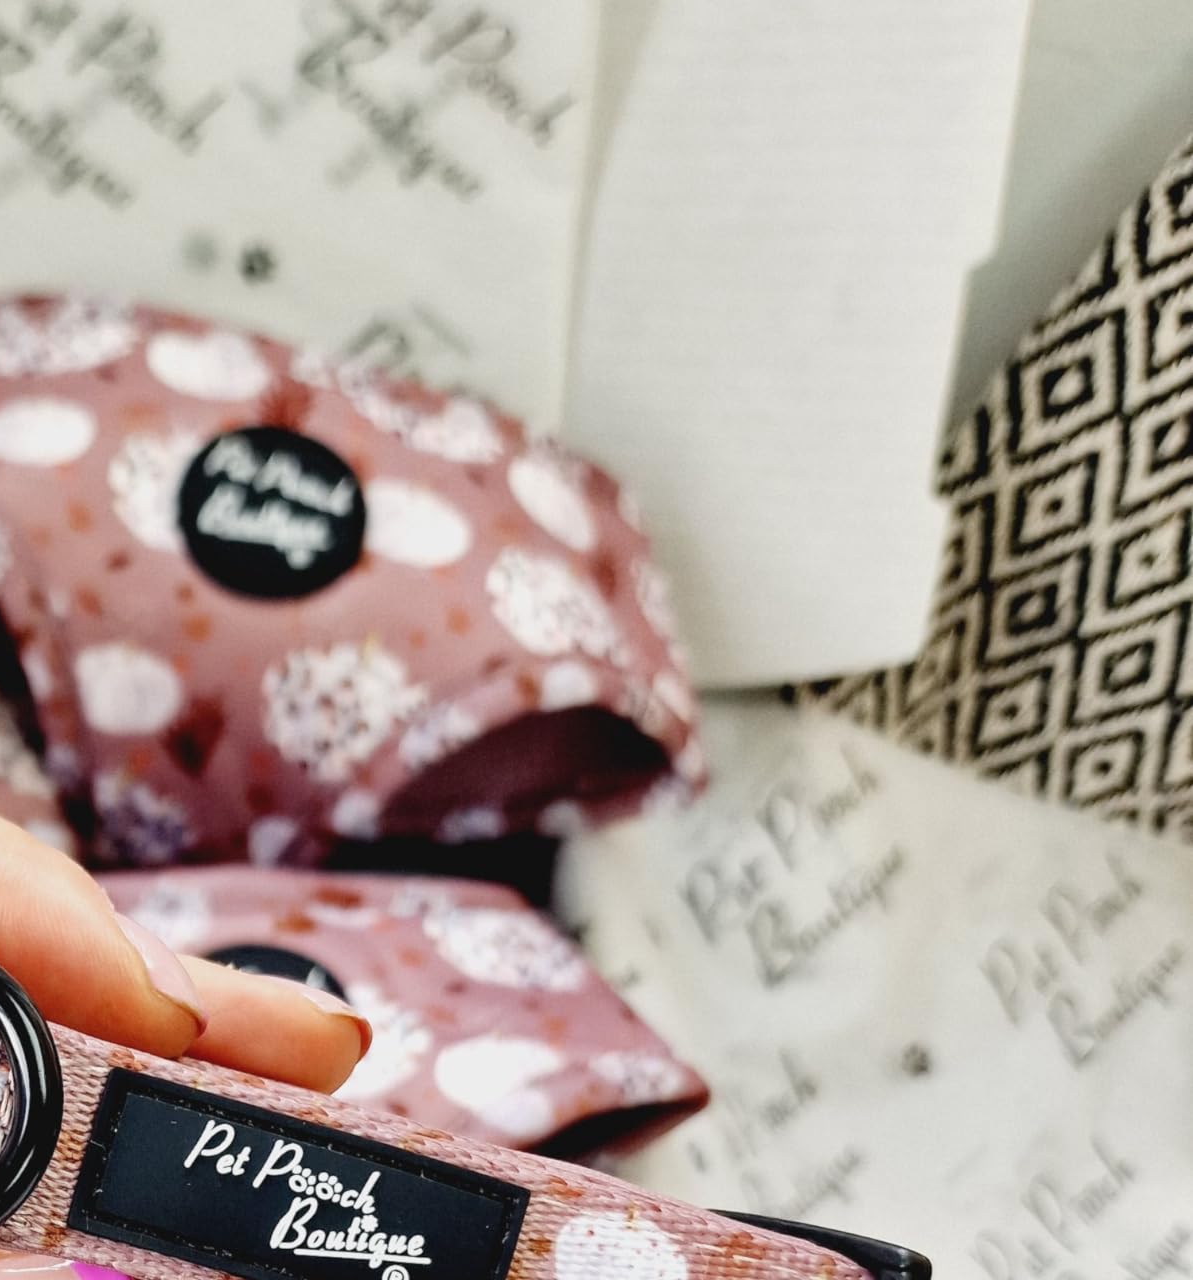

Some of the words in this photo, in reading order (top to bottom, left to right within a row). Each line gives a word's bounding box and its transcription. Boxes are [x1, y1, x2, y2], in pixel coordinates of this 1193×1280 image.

[184, 1119, 251, 1177] Pet
[252, 1139, 381, 1213] Pooch
[269, 1196, 428, 1270] Boutique
